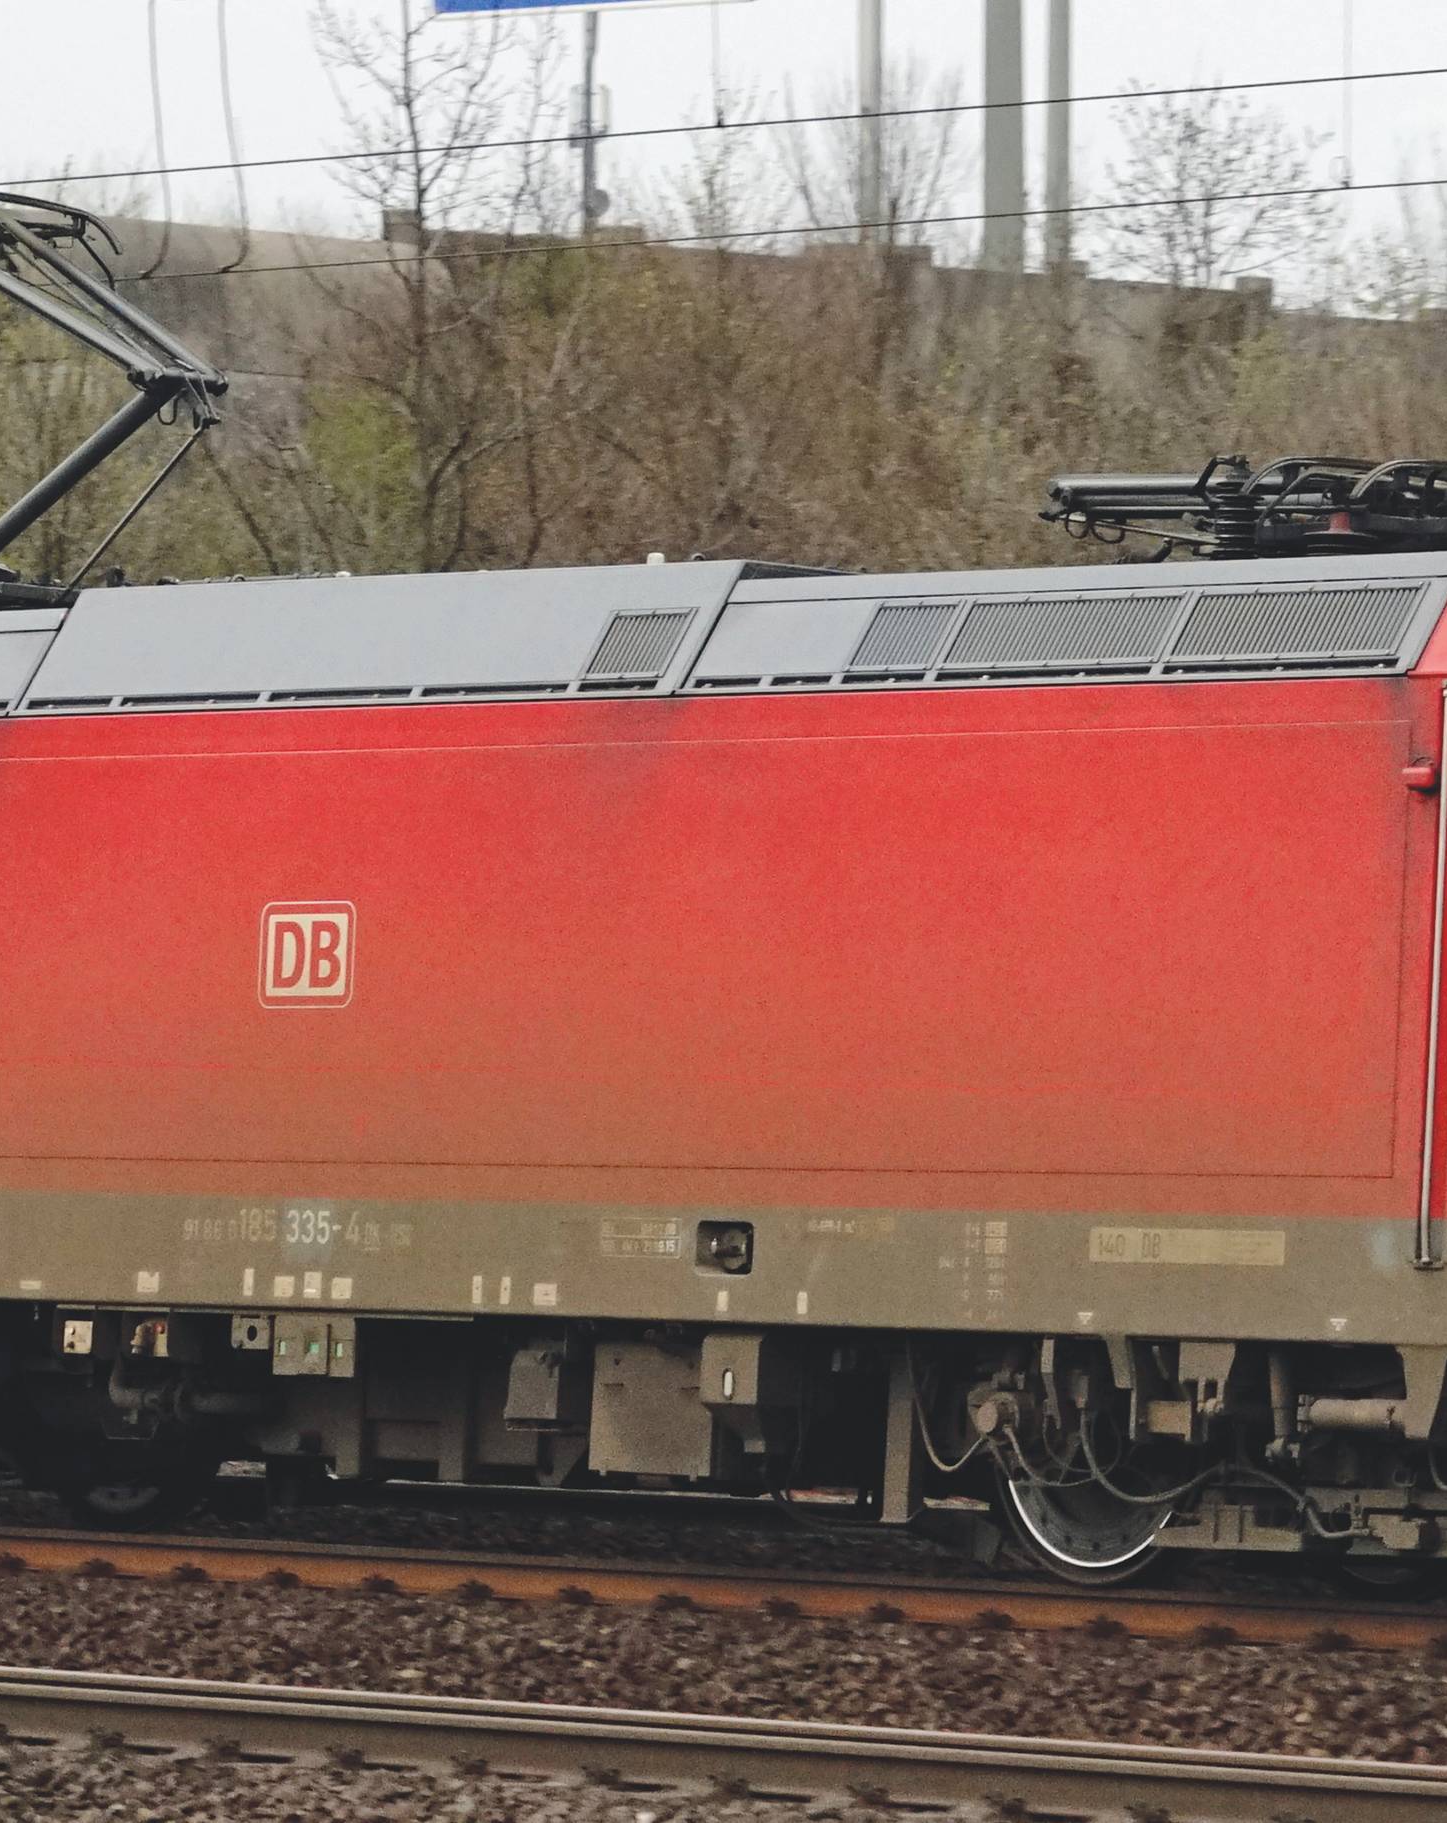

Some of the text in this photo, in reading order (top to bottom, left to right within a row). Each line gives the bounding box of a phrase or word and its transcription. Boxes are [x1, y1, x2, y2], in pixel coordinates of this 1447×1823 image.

[272, 920, 341, 988] DB
[239, 1208, 277, 1243] 185
[285, 1209, 361, 1246] 335-4
